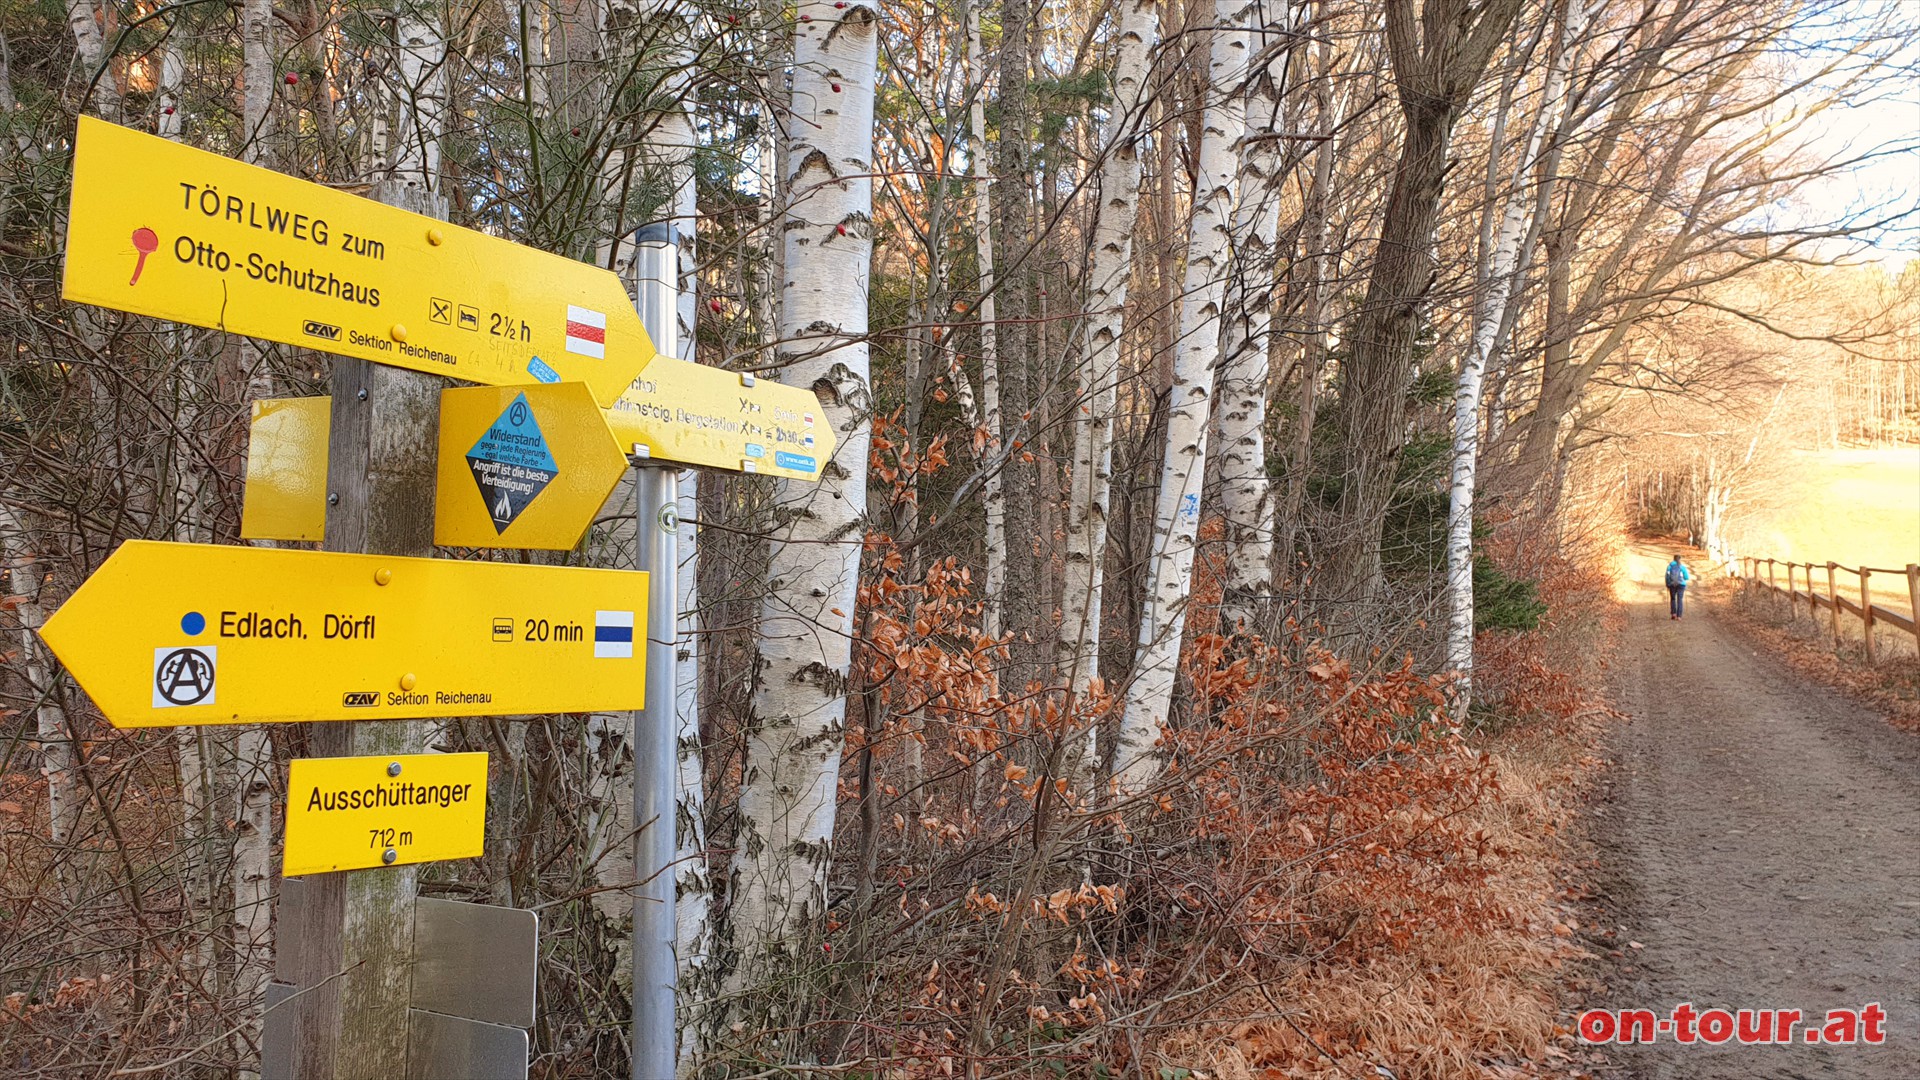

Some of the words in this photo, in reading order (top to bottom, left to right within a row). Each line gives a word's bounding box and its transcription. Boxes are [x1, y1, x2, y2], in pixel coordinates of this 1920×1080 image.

[180, 182, 328, 246] TÖRLWEG
[342, 233, 385, 260] zum
[174, 235, 380, 307] Otto-Schutzhaus
[520, 320, 530, 342] h
[349, 330, 392, 350] Sektion
[399, 342, 457, 365] Reichenau
[490, 428, 541, 447] Widerstand
[485, 452, 498, 460] egal
[500, 454, 520, 464] welche
[522, 456, 538, 466] Farbe
[500, 444, 513, 453] jede
[515, 446, 546, 460] Regierung
[474, 460, 500, 474] Angriff
[501, 464, 511, 476] ist
[512, 466, 524, 478] die
[526, 468, 549, 482] beste
[482, 474, 534, 495] Verteidigung!
[324, 614, 375, 639] Dörfl
[525, 619, 548, 642] 20
[554, 621, 583, 642] min
[387, 692, 428, 706] Sektion
[436, 692, 492, 704] Reichenau
[307, 782, 472, 812] Ausschüttanger
[370, 828, 394, 848] 712
[400, 830, 412, 846] m
